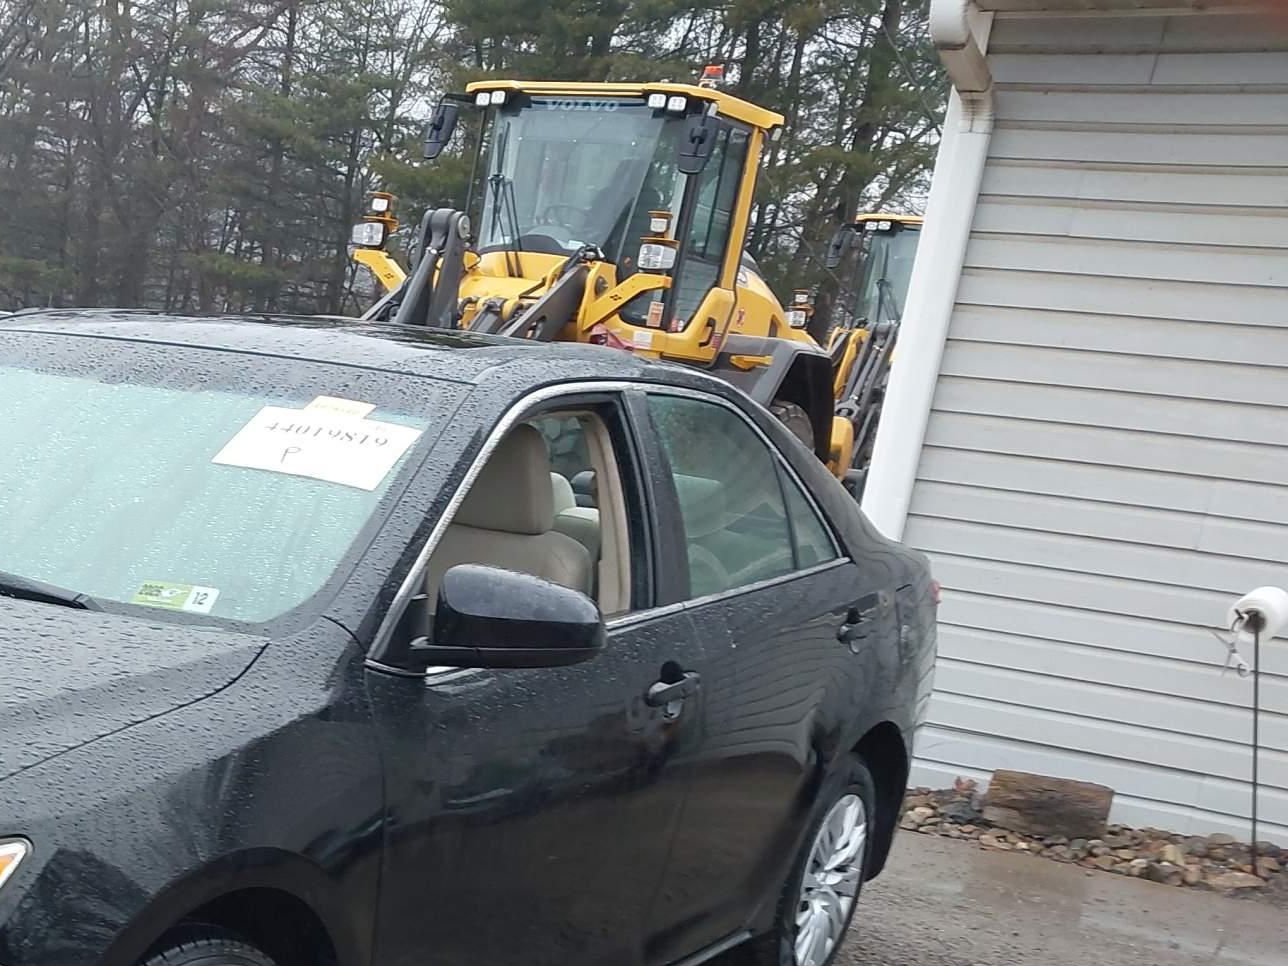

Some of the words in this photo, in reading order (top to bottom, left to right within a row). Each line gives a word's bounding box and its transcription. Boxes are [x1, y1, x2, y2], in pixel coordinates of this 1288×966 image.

[546, 100, 619, 112] VOLVO
[264, 421, 389, 447] 44019819
[279, 446, 302, 464] P
[192, 591, 209, 606] 12
